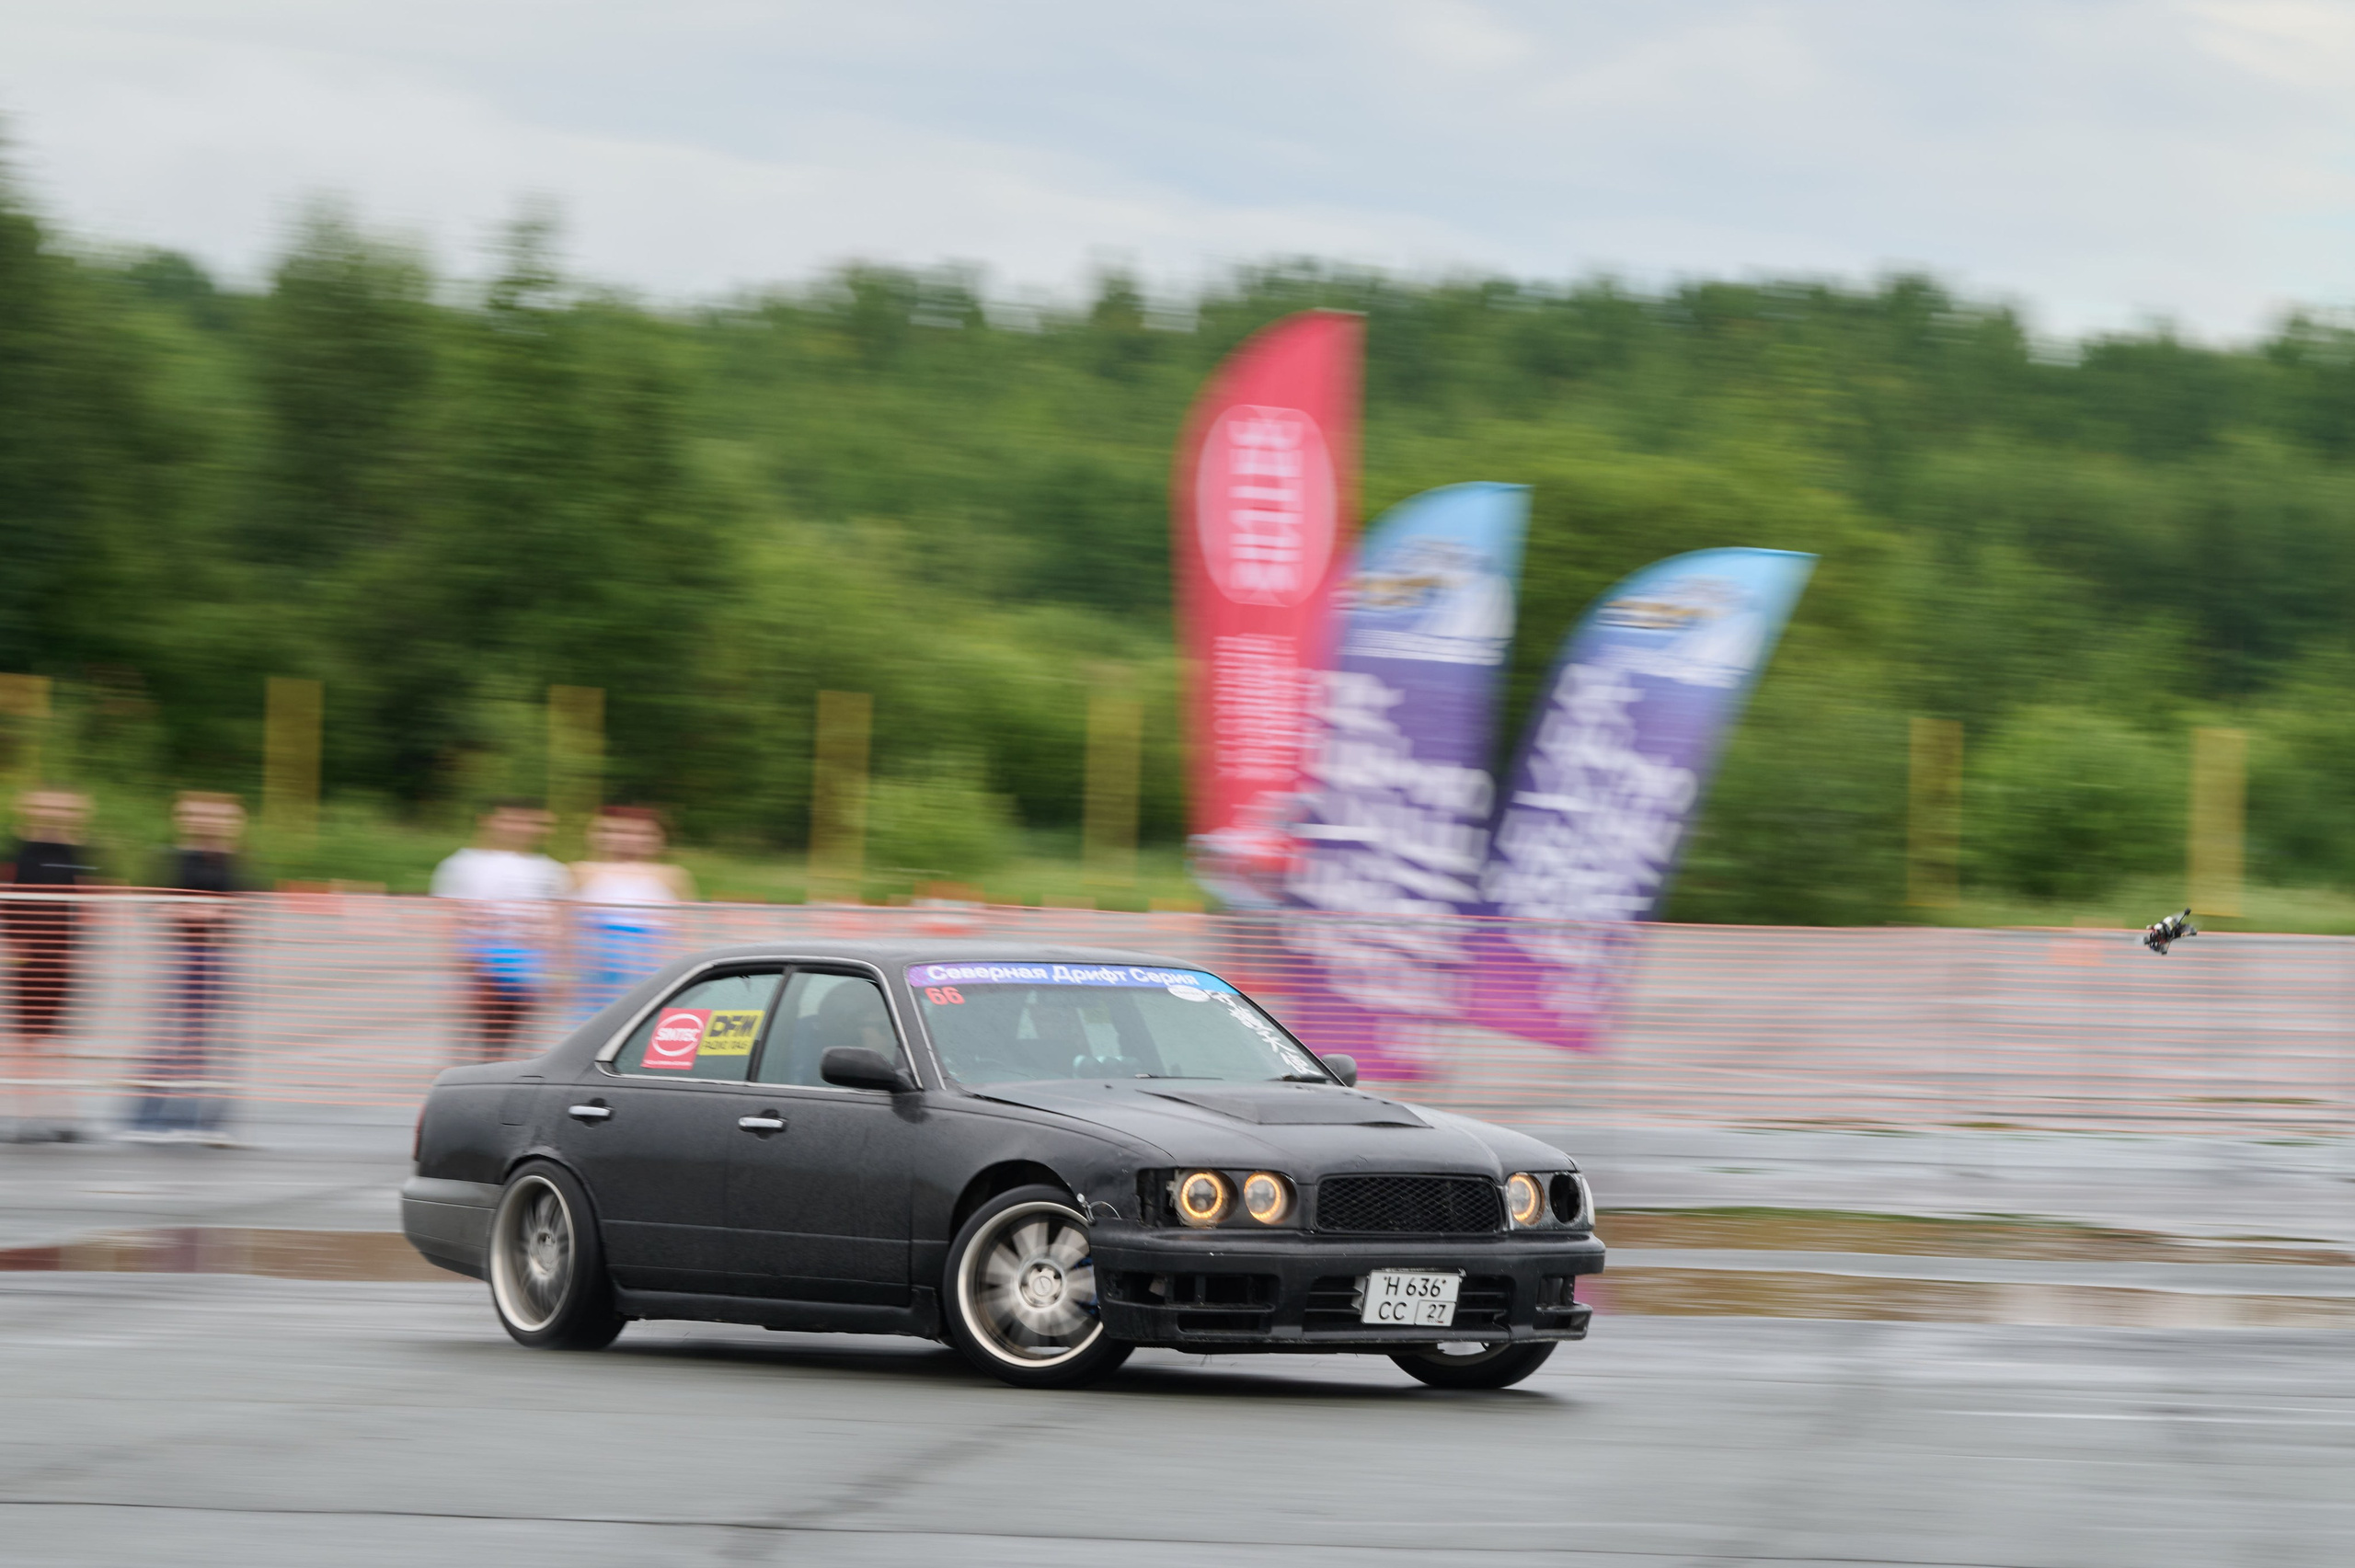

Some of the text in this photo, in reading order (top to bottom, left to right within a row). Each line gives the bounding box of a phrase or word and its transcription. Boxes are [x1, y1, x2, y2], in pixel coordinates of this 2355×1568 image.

[926, 966, 1200, 986] Северная Дрифт Серия
[925, 986, 965, 1005] 66
[654, 1027, 702, 1042] SINTEC
[709, 1014, 758, 1037] DFM
[1406, 1276, 1442, 1298] 636
[1427, 1303, 1446, 1319] 27
